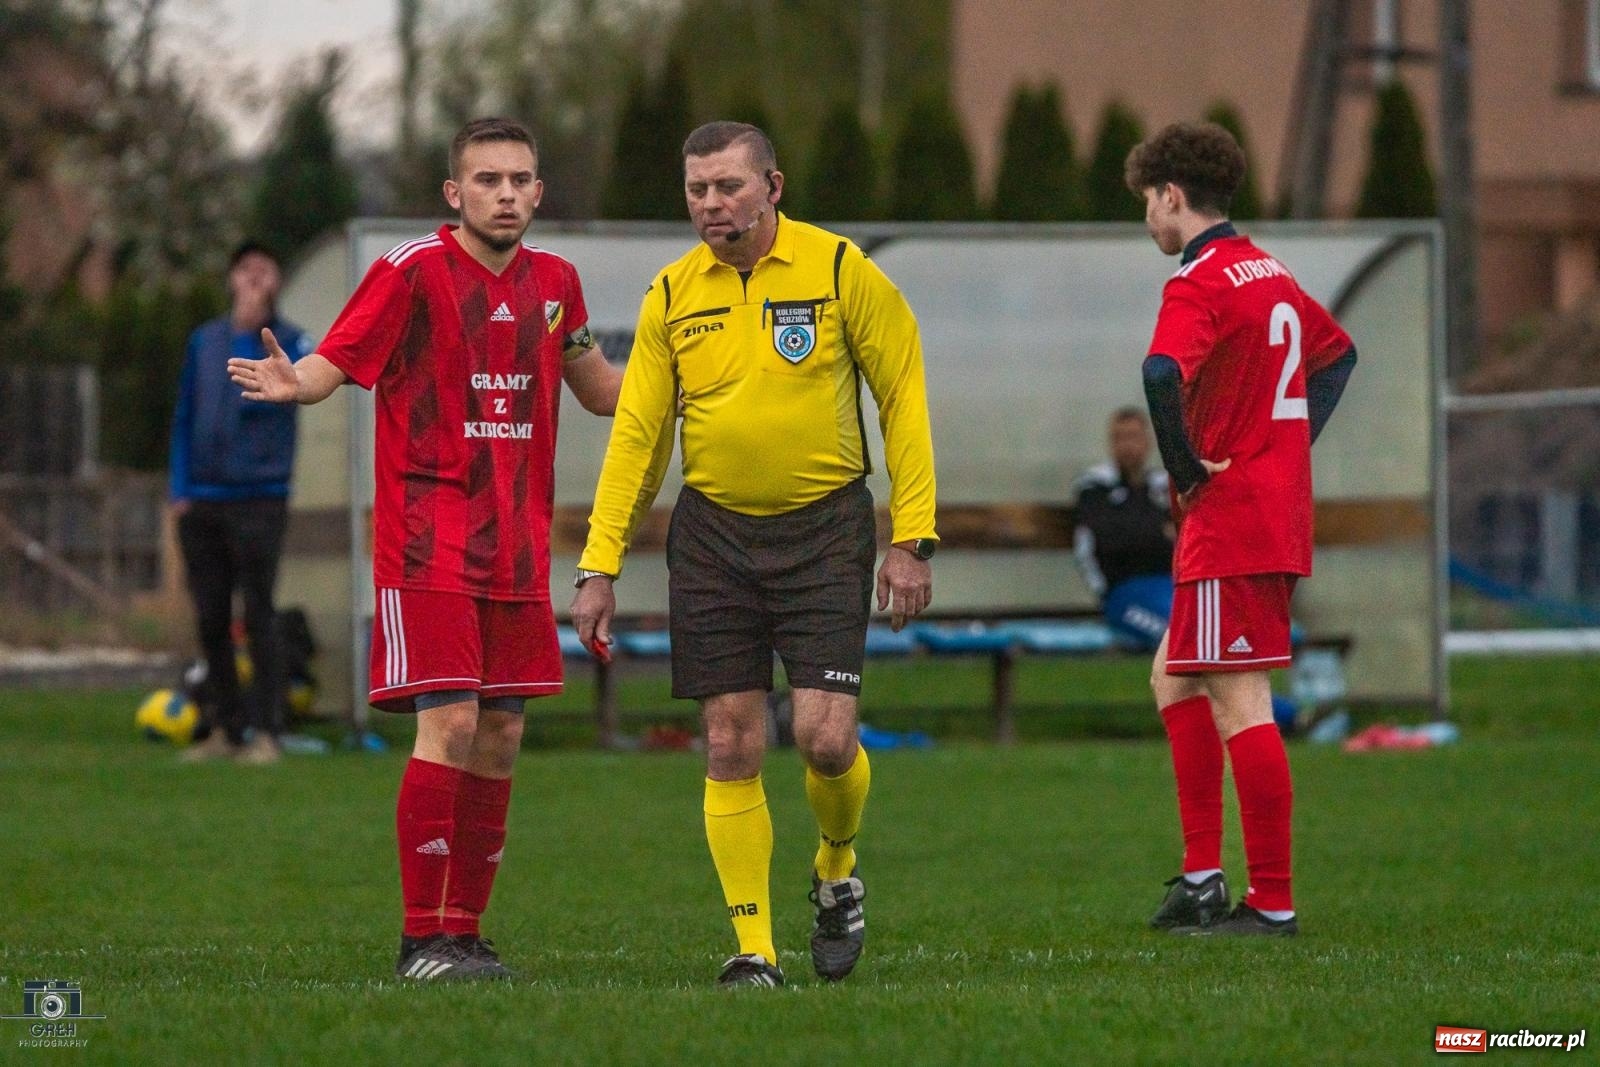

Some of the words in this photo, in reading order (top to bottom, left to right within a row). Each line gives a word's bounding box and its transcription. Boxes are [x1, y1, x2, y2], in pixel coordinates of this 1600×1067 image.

[775, 308, 812, 317] KOLEGIUM
[682, 321, 724, 338] zina
[1269, 302, 1309, 420] 2
[471, 373, 532, 390] GRAMY
[494, 398, 507, 414] Z
[464, 421, 533, 439] KIBICAMI
[824, 670, 861, 684] zina
[729, 902, 758, 918] ina
